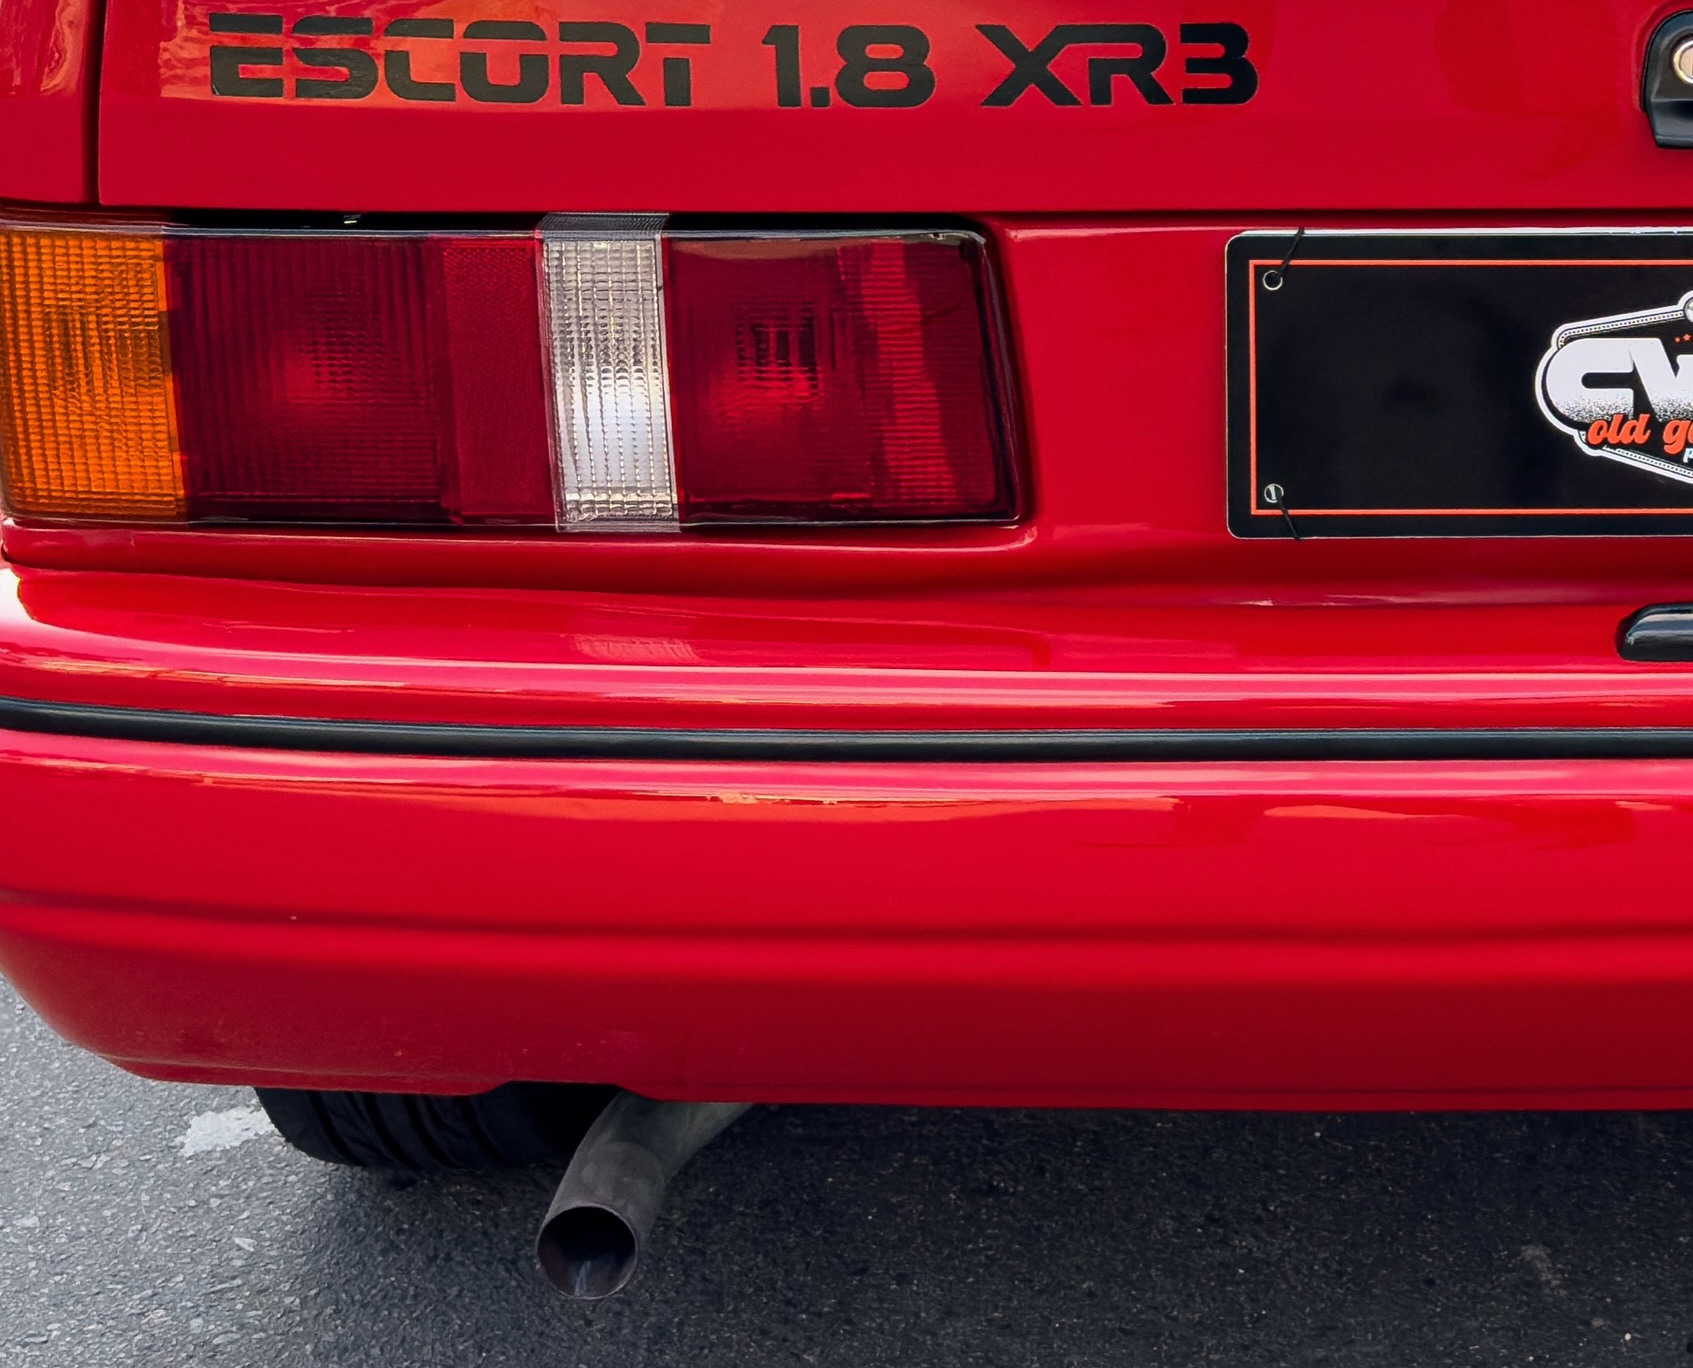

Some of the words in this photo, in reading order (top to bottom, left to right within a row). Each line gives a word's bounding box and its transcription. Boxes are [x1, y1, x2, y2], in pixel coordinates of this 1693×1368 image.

[207, 12, 712, 106] ESCORT
[762, 24, 937, 108] 1.8
[974, 22, 1259, 107] XR3
[1587, 413, 1651, 445] old
